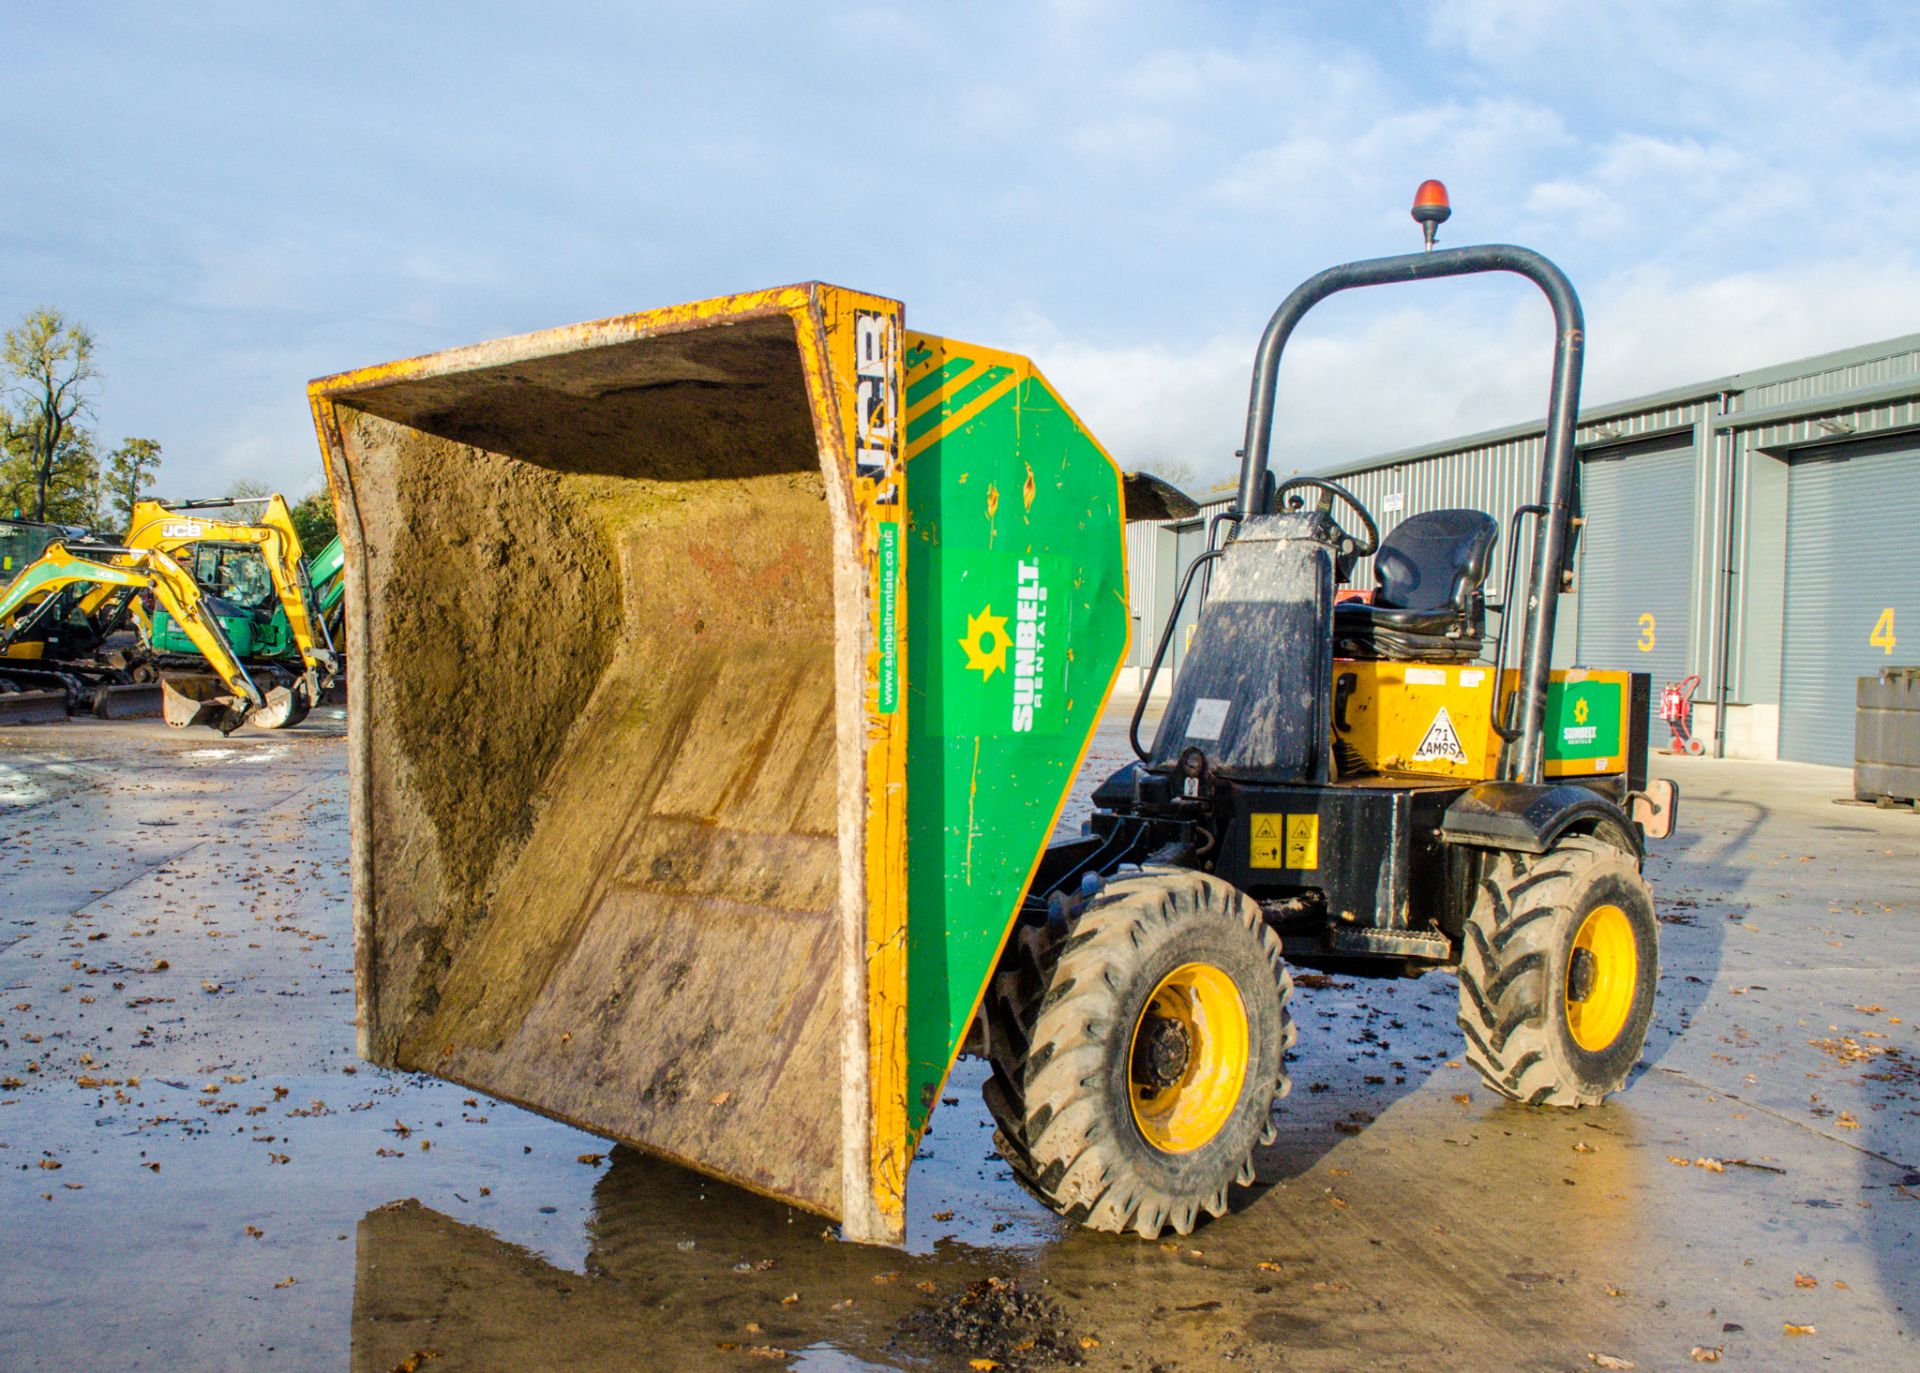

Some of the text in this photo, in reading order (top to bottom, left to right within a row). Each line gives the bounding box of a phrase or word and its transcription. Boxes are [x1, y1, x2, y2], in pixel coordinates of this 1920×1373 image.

[857, 316, 896, 500] JCB
[162, 524, 202, 537] JCB
[884, 529, 893, 705] www.sunbeltrentals.co.uk
[1012, 559, 1039, 733] SUNBELT
[1033, 587, 1048, 709] RENTALS
[1637, 612, 1656, 652] 3
[1869, 608, 1897, 655] 4
